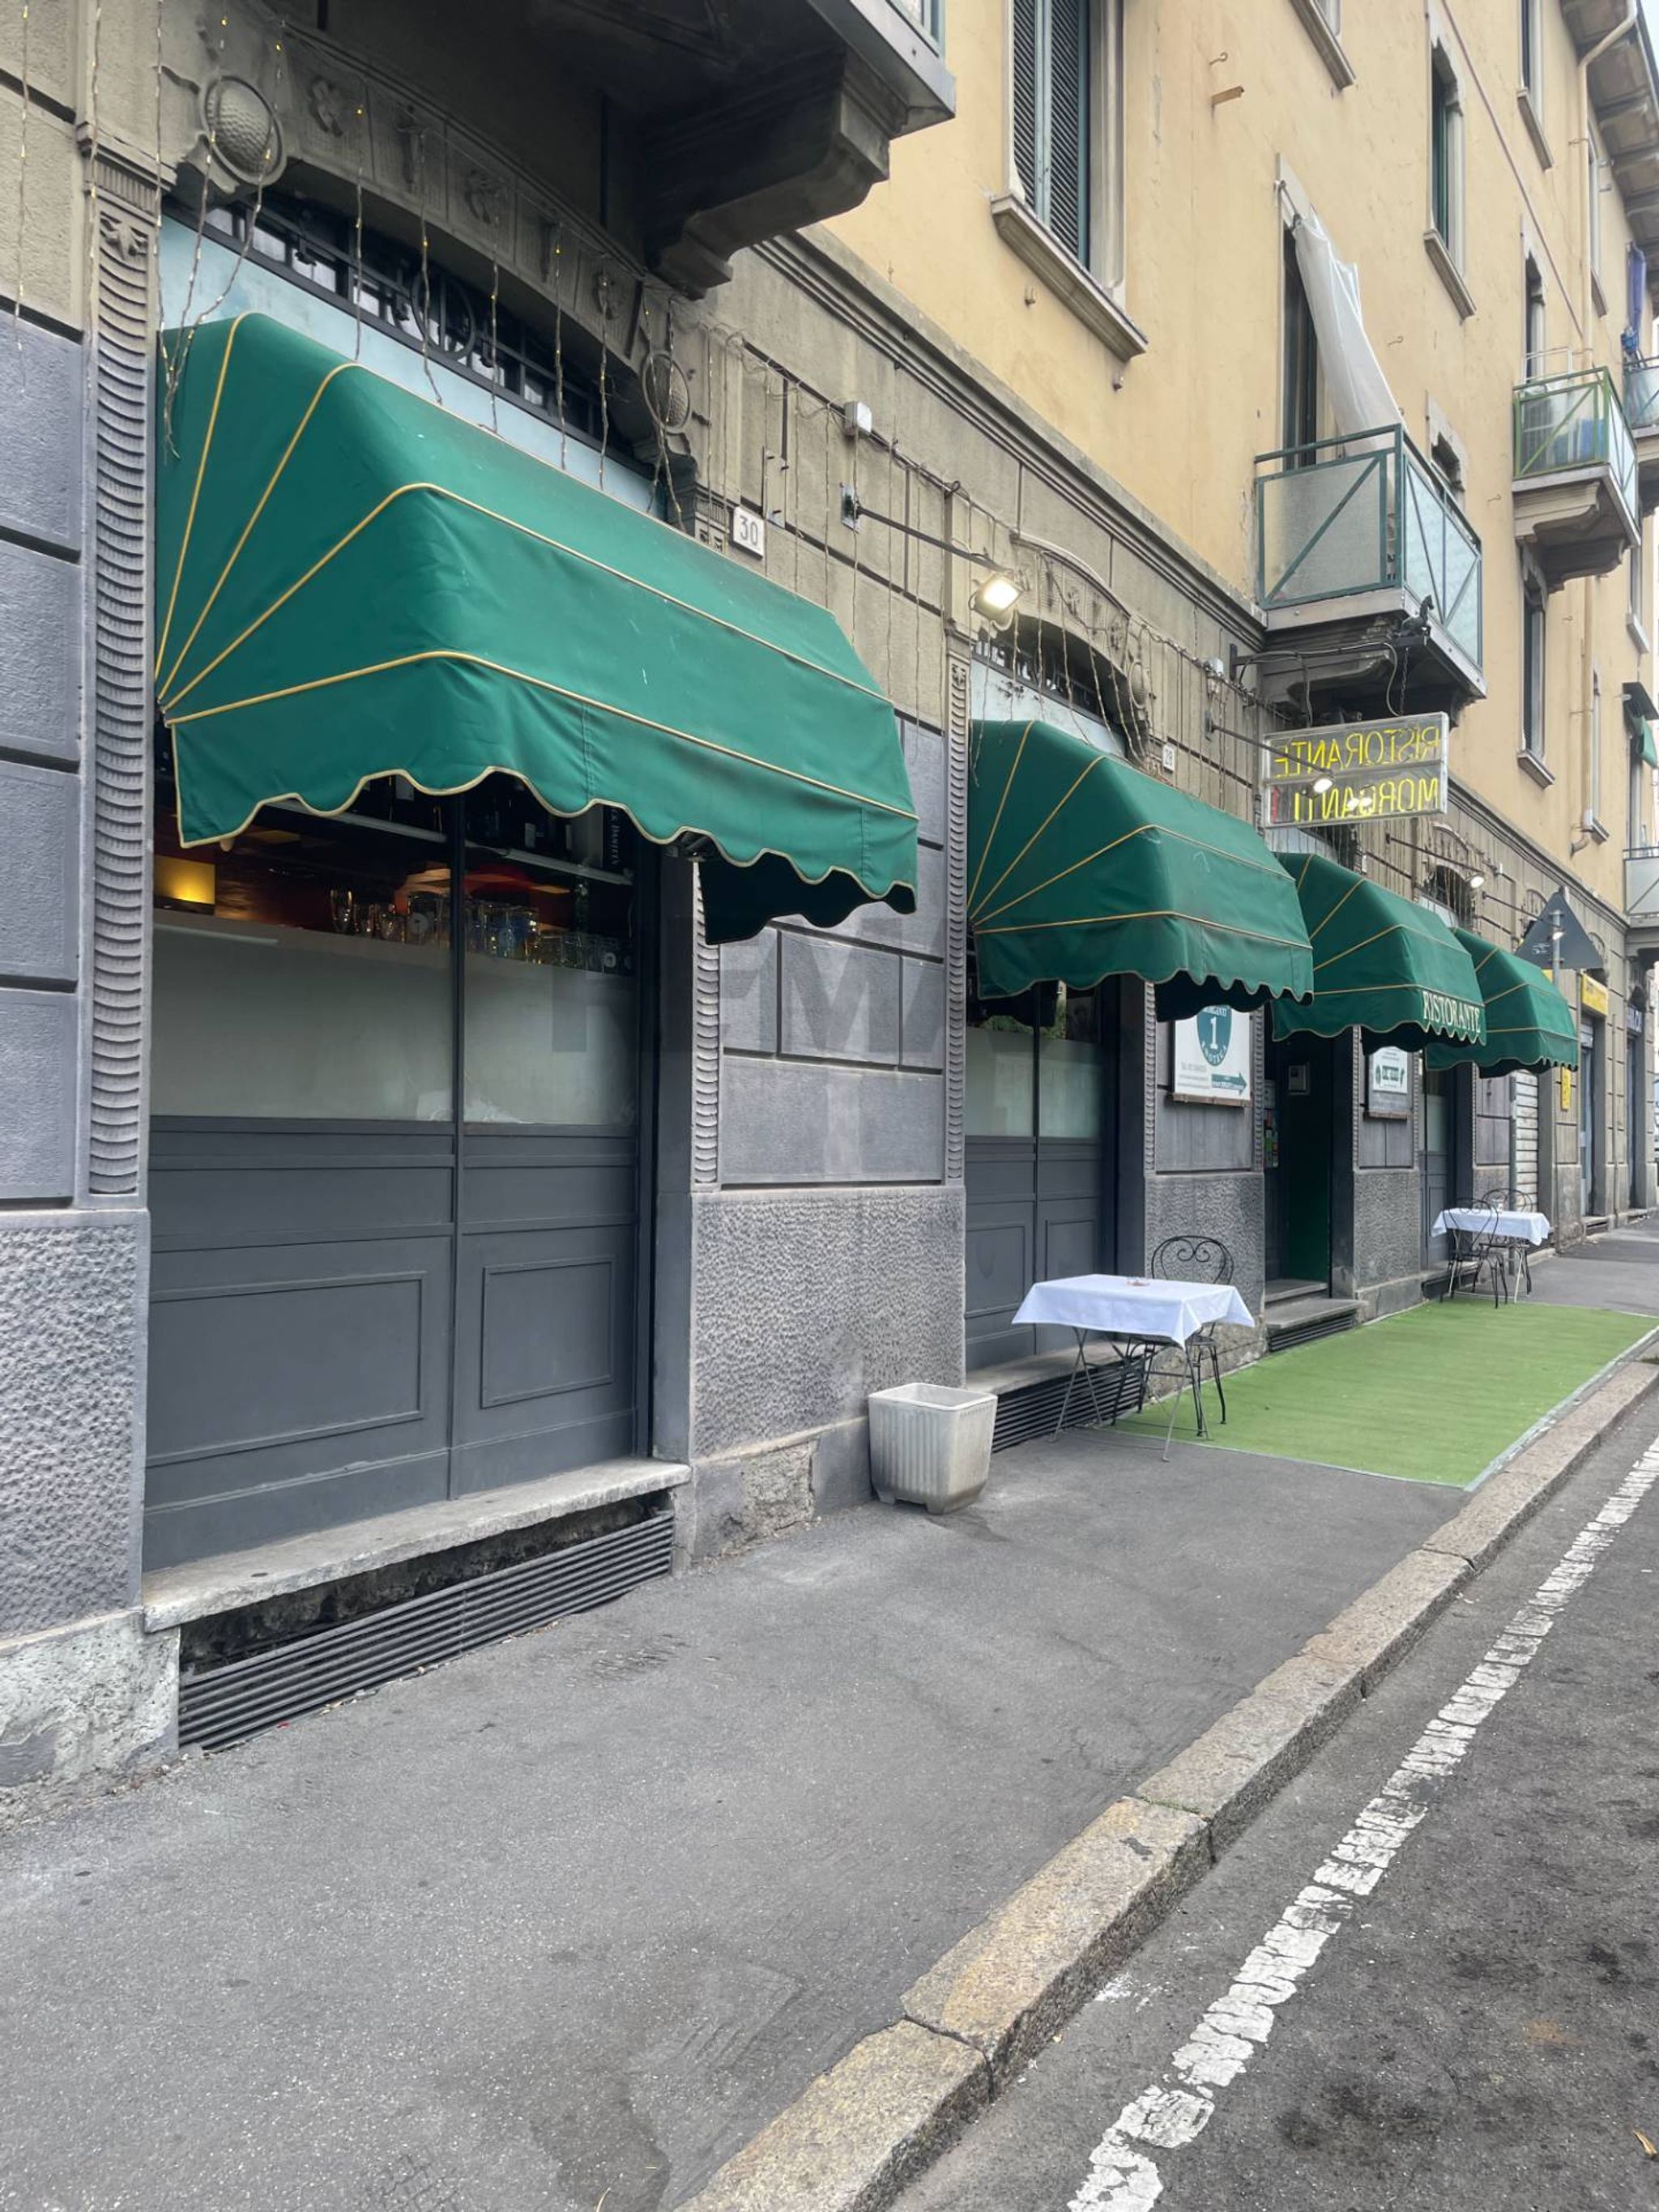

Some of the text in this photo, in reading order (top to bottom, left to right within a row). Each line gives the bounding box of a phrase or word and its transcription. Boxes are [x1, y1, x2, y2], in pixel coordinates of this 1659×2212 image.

[740, 514, 758, 546] 30
[1422, 991, 1481, 1034] RISTORANTE
[1209, 1016, 1218, 1050] 1
